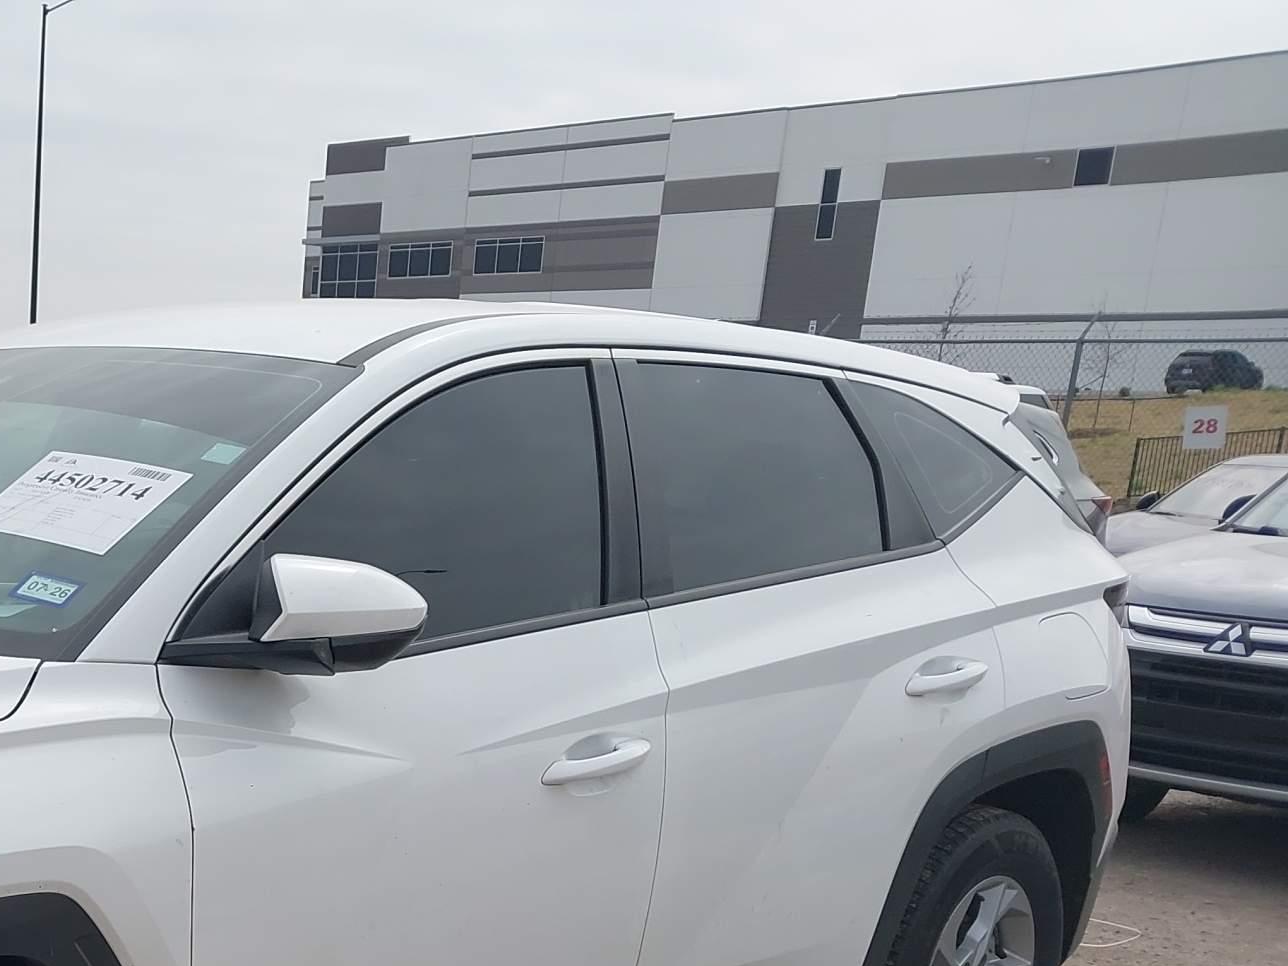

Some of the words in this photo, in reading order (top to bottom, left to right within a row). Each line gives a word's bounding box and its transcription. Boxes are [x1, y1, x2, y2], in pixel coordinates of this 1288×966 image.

[1191, 418, 1219, 434] 28
[33, 468, 154, 501] 44502714
[49, 586, 71, 599] 26
